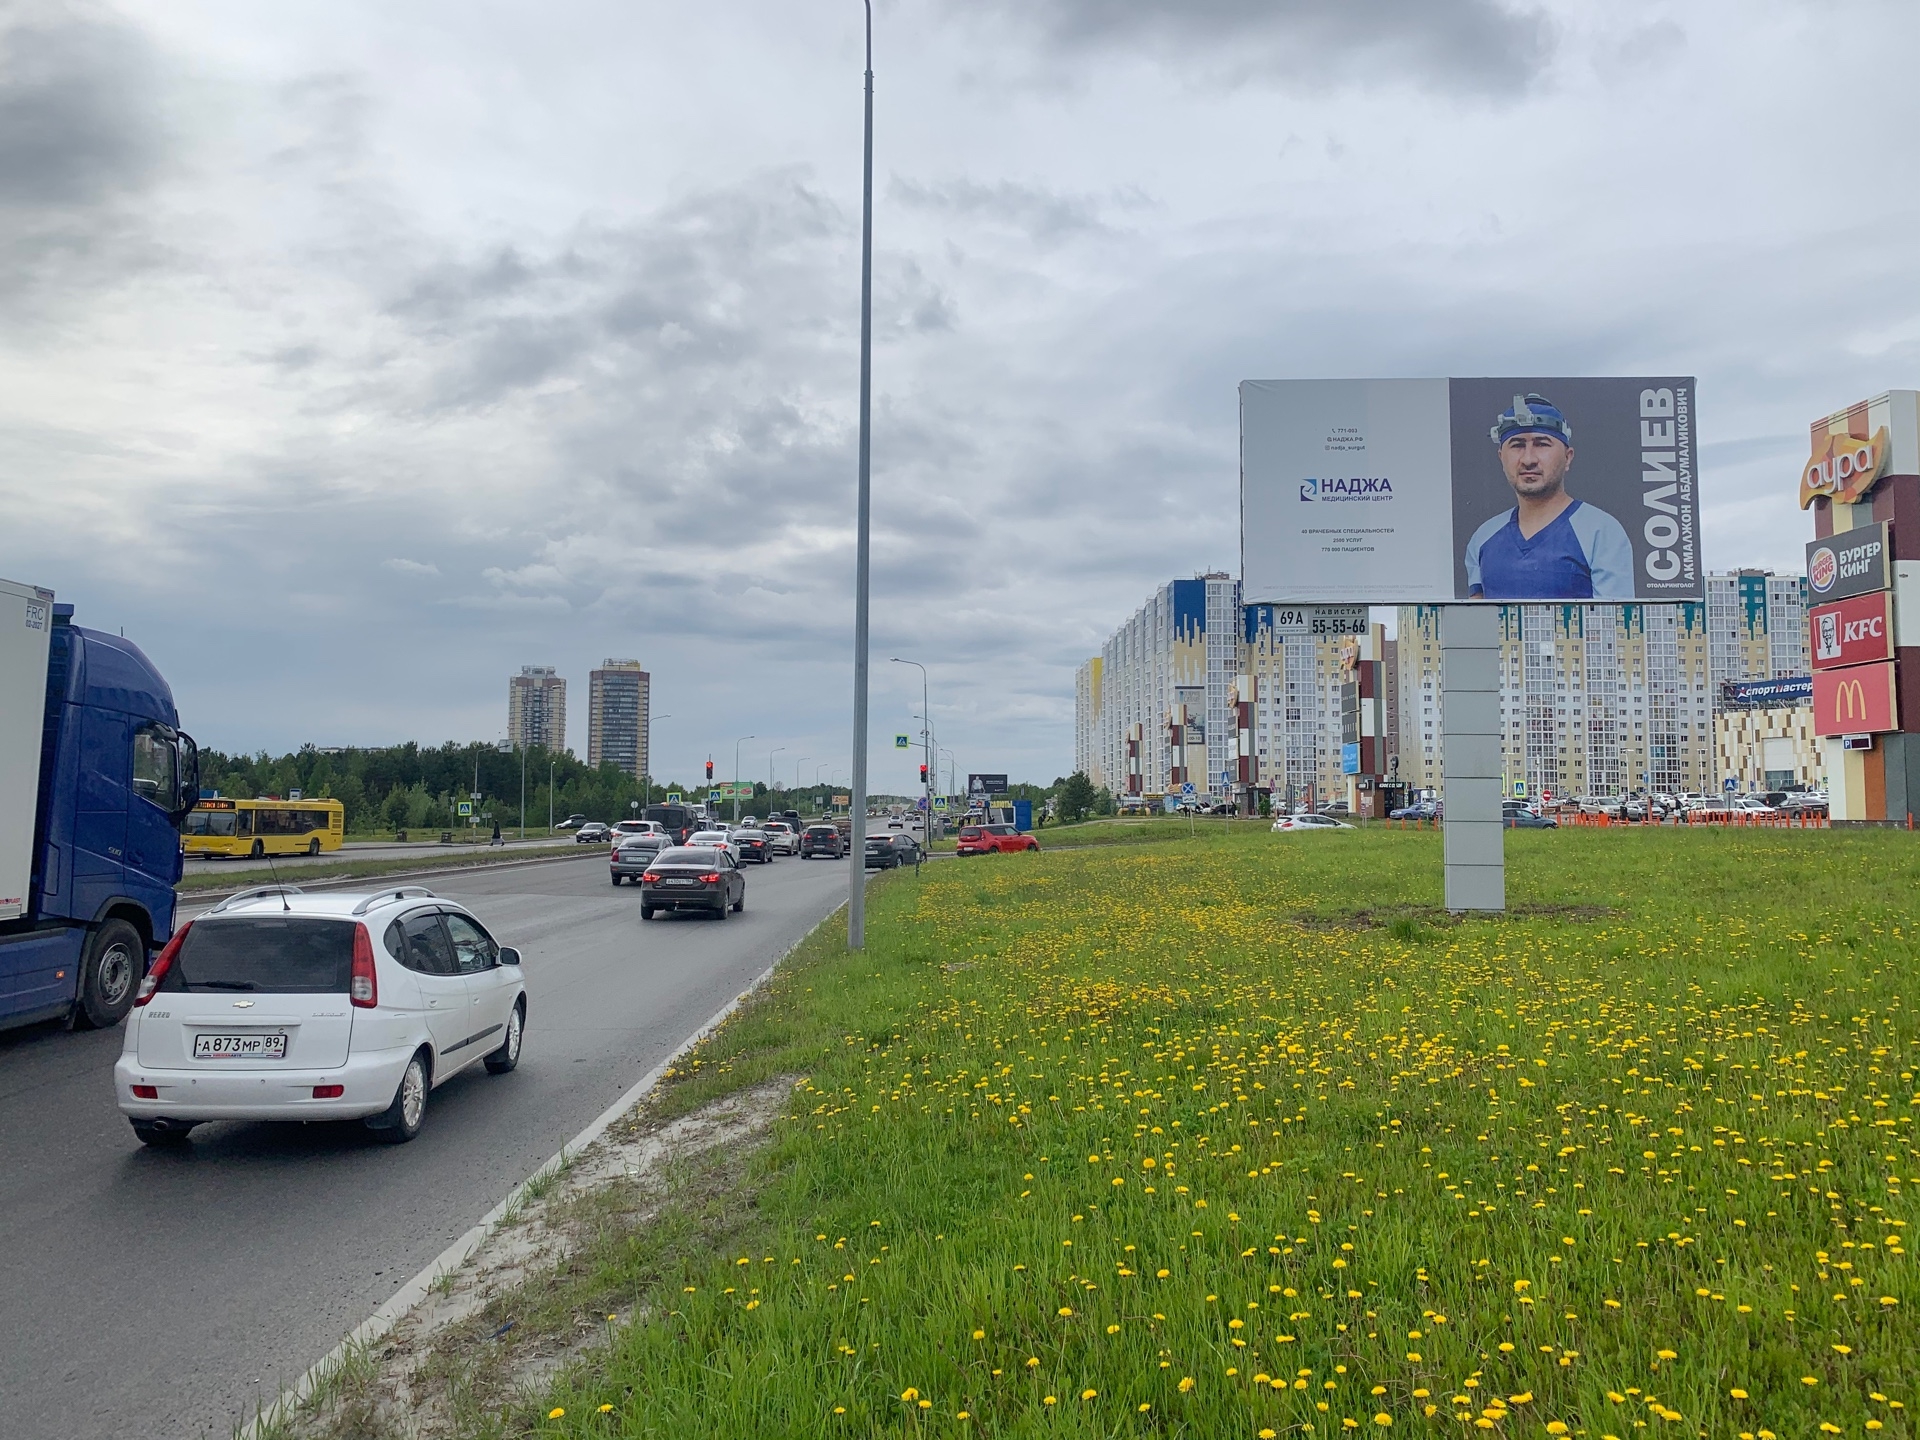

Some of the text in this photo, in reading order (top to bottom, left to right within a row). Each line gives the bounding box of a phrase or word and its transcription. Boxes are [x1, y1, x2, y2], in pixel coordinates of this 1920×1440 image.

[1807, 446, 1874, 495] аура
[1321, 478, 1393, 495] НАДЖА
[1640, 388, 1680, 581] СОЛИЕВ
[1677, 388, 1694, 580] АКМАЛЖОН АБДУМАЛИКОВИЧ
[1839, 541, 1881, 565] БУРГЕР
[1812, 554, 1833, 574] BURGER
[1813, 564, 1834, 584] KING
[1840, 559, 1871, 579] КИНГ
[26, 605, 44, 620] FRC
[1280, 611, 1294, 625] 69
[1312, 619, 1366, 634] 55-55-66
[1843, 616, 1882, 643] KFC
[265, 1037, 280, 1048] 89
